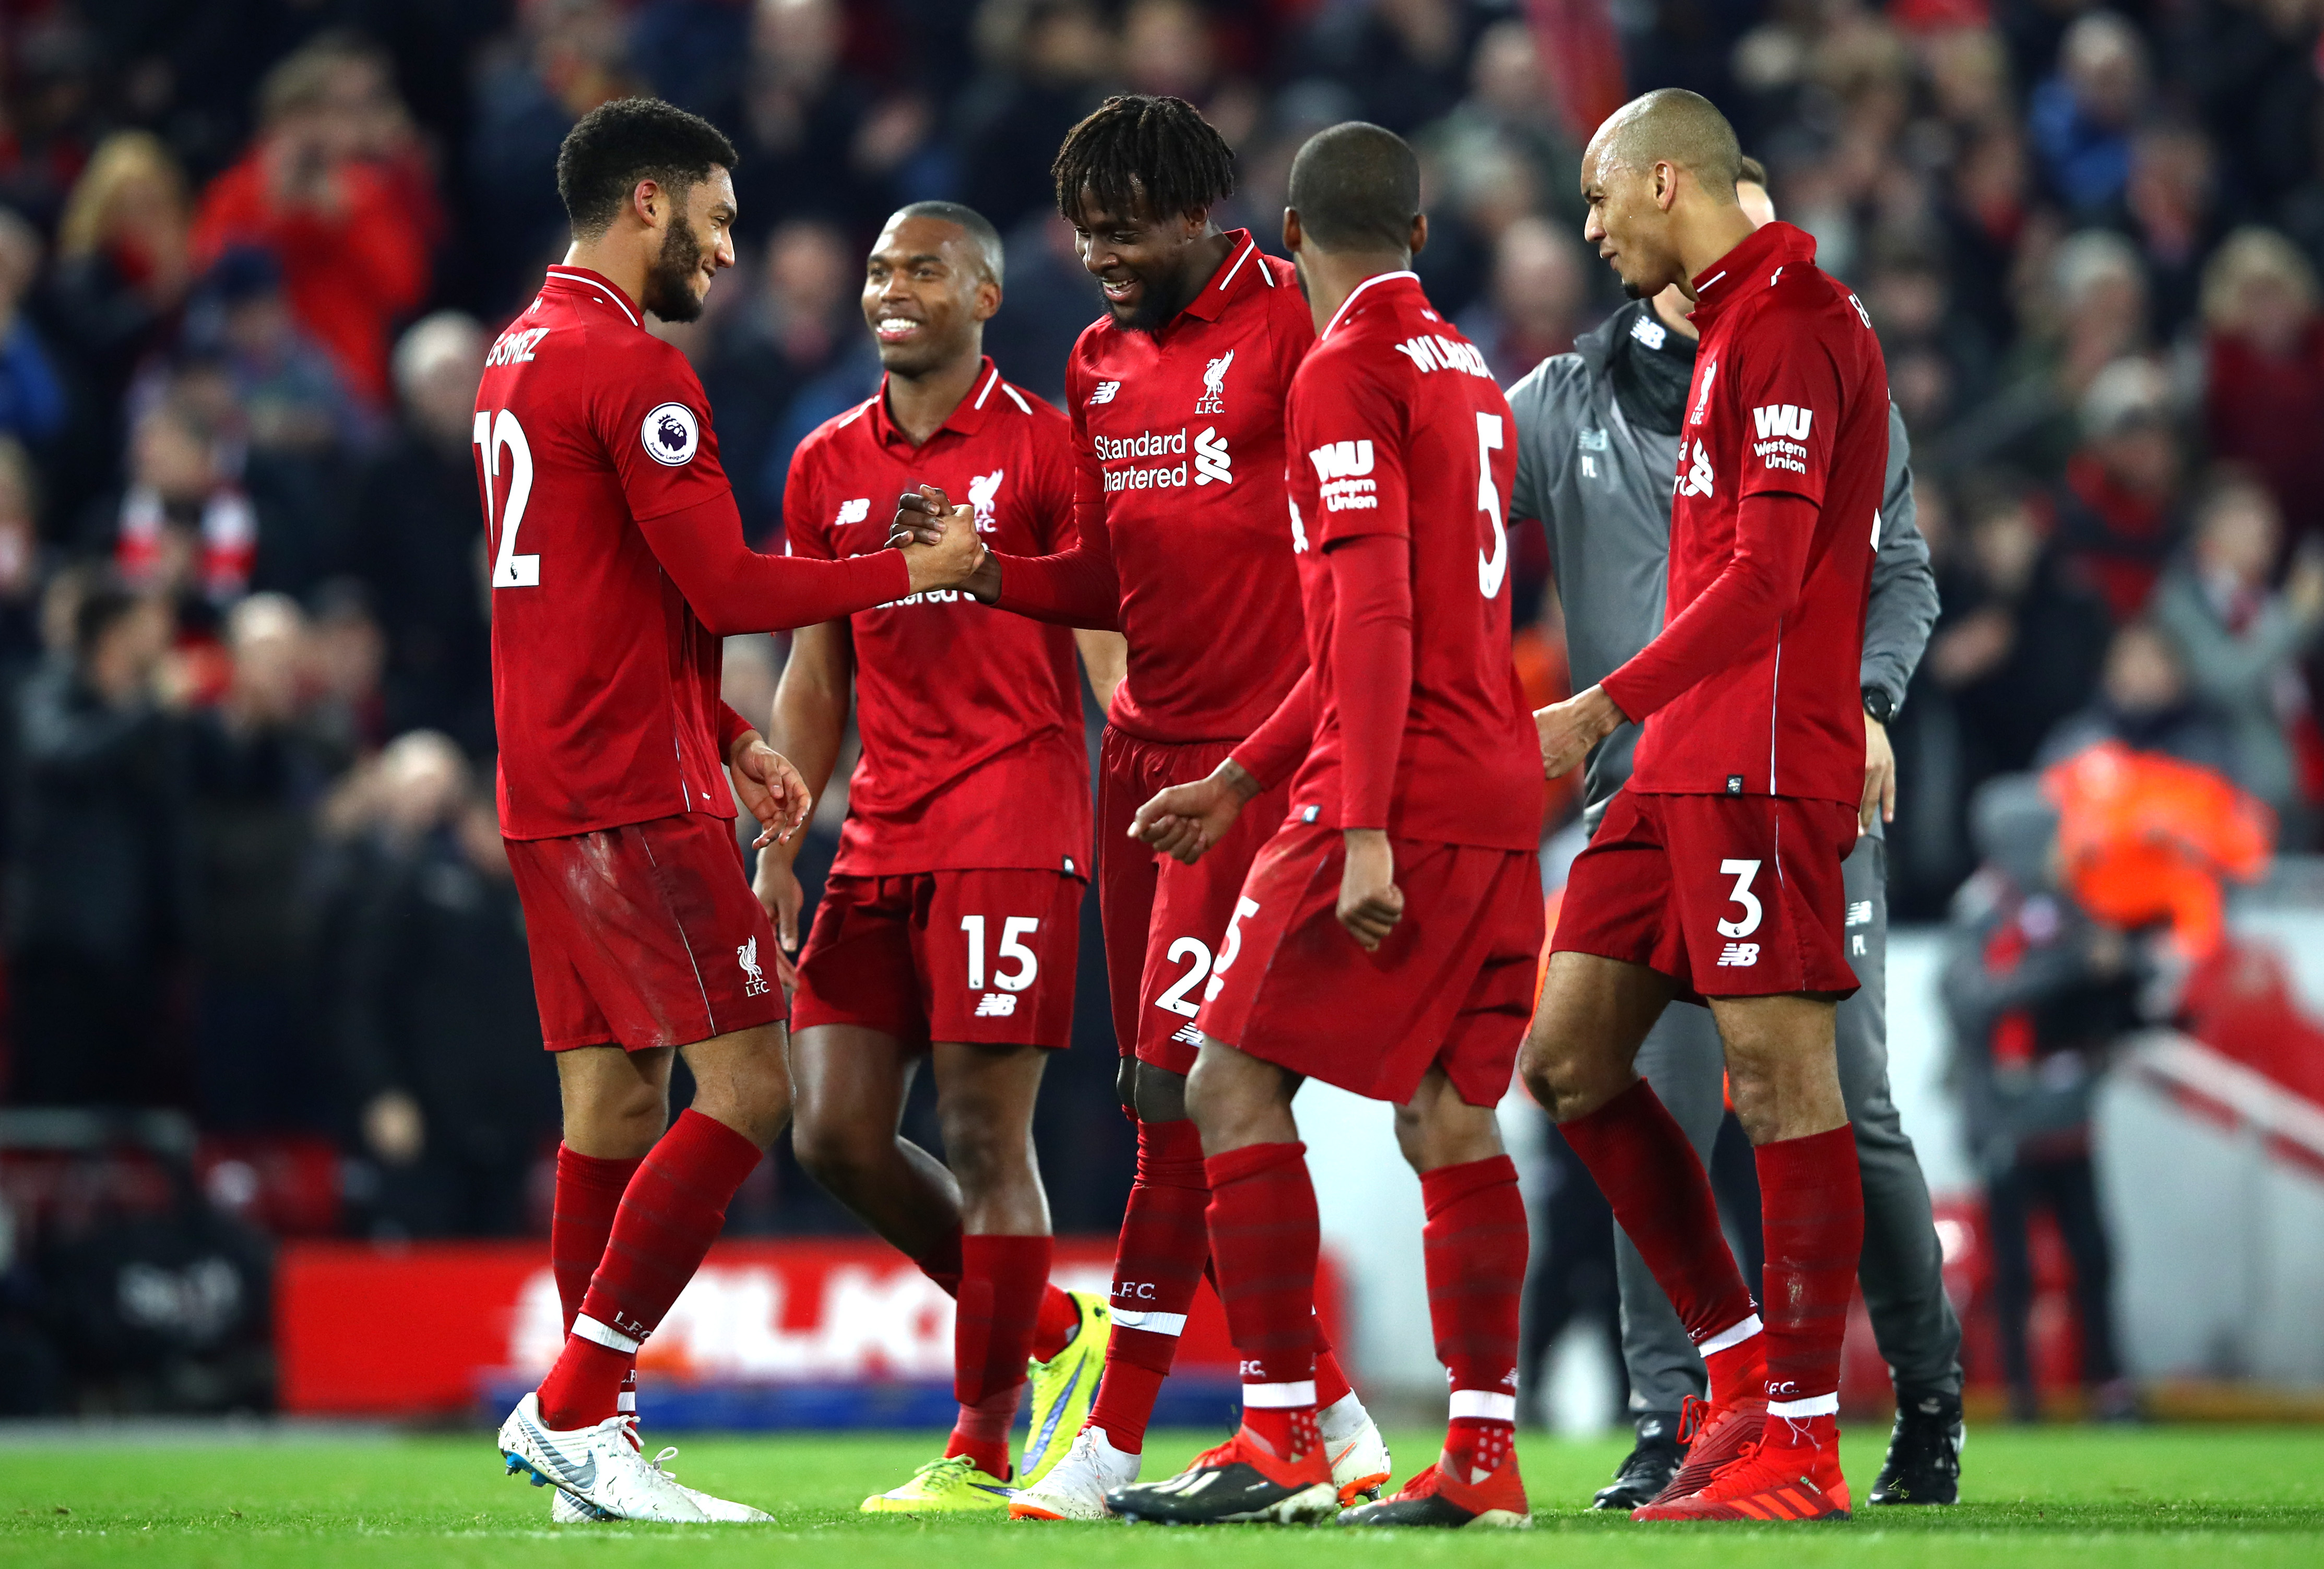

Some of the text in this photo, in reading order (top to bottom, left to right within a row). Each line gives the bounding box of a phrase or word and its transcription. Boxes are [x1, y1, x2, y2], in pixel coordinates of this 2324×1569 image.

[485, 327, 551, 367] GOMEZ
[1395, 334, 1495, 380] WIJNALD
[1753, 404, 1812, 441] WU
[650, 442, 665, 457] Premier
[1094, 427, 1186, 460] Standard
[1309, 439, 1374, 483] WU
[1753, 439, 1807, 459] Western
[1765, 453, 1806, 474] Union
[1102, 461, 1188, 492] hartered
[1320, 479, 1377, 500] estern
[473, 408, 540, 588] 12
[1326, 492, 1378, 512] Union
[1476, 411, 1507, 599] 5
[1717, 859, 1762, 938] 3
[960, 914, 1039, 992] 15
[1213, 895, 1260, 974] 5
[1154, 936, 1212, 1018] 2
